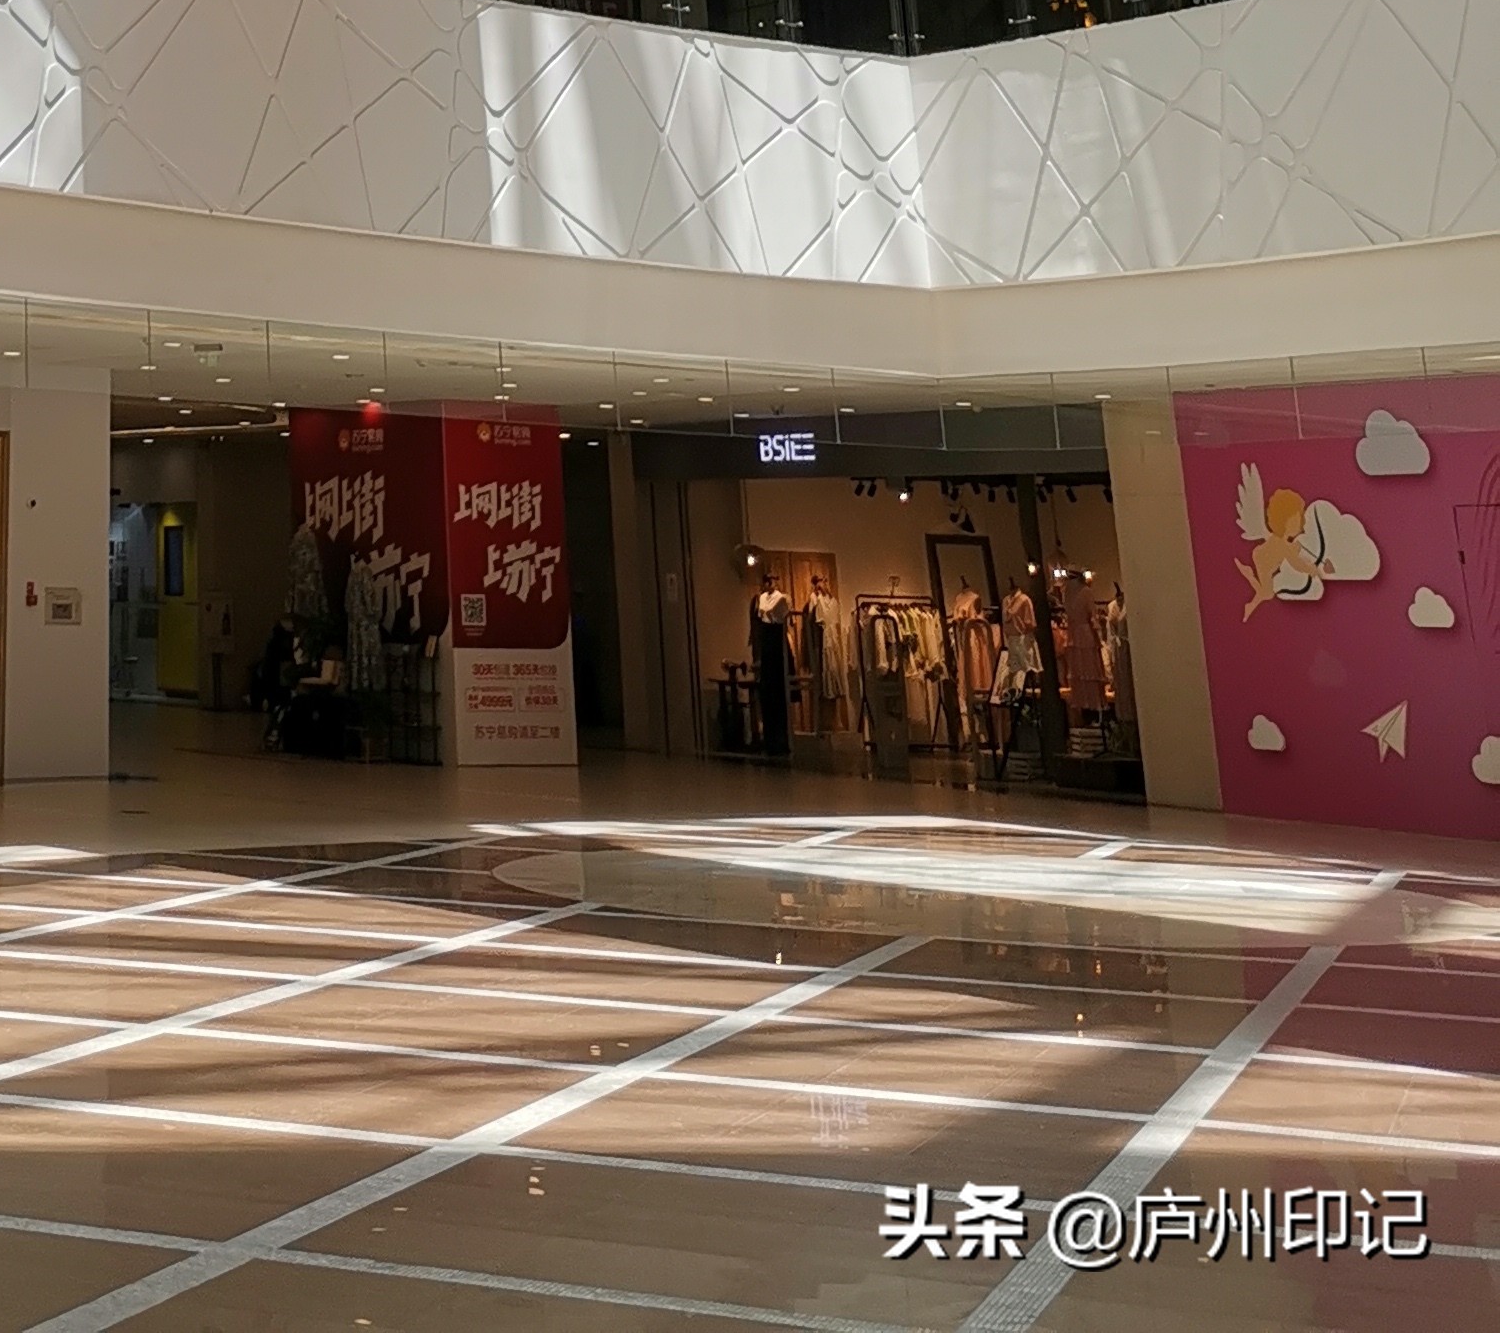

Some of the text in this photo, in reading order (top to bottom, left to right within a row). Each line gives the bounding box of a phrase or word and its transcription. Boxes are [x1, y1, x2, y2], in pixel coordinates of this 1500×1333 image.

[304, 469, 385, 544] 上网上街
[453, 479, 541, 532] 上网上街
[350, 542, 431, 635] 苏宁
[483, 538, 561, 603] 上苏宁
